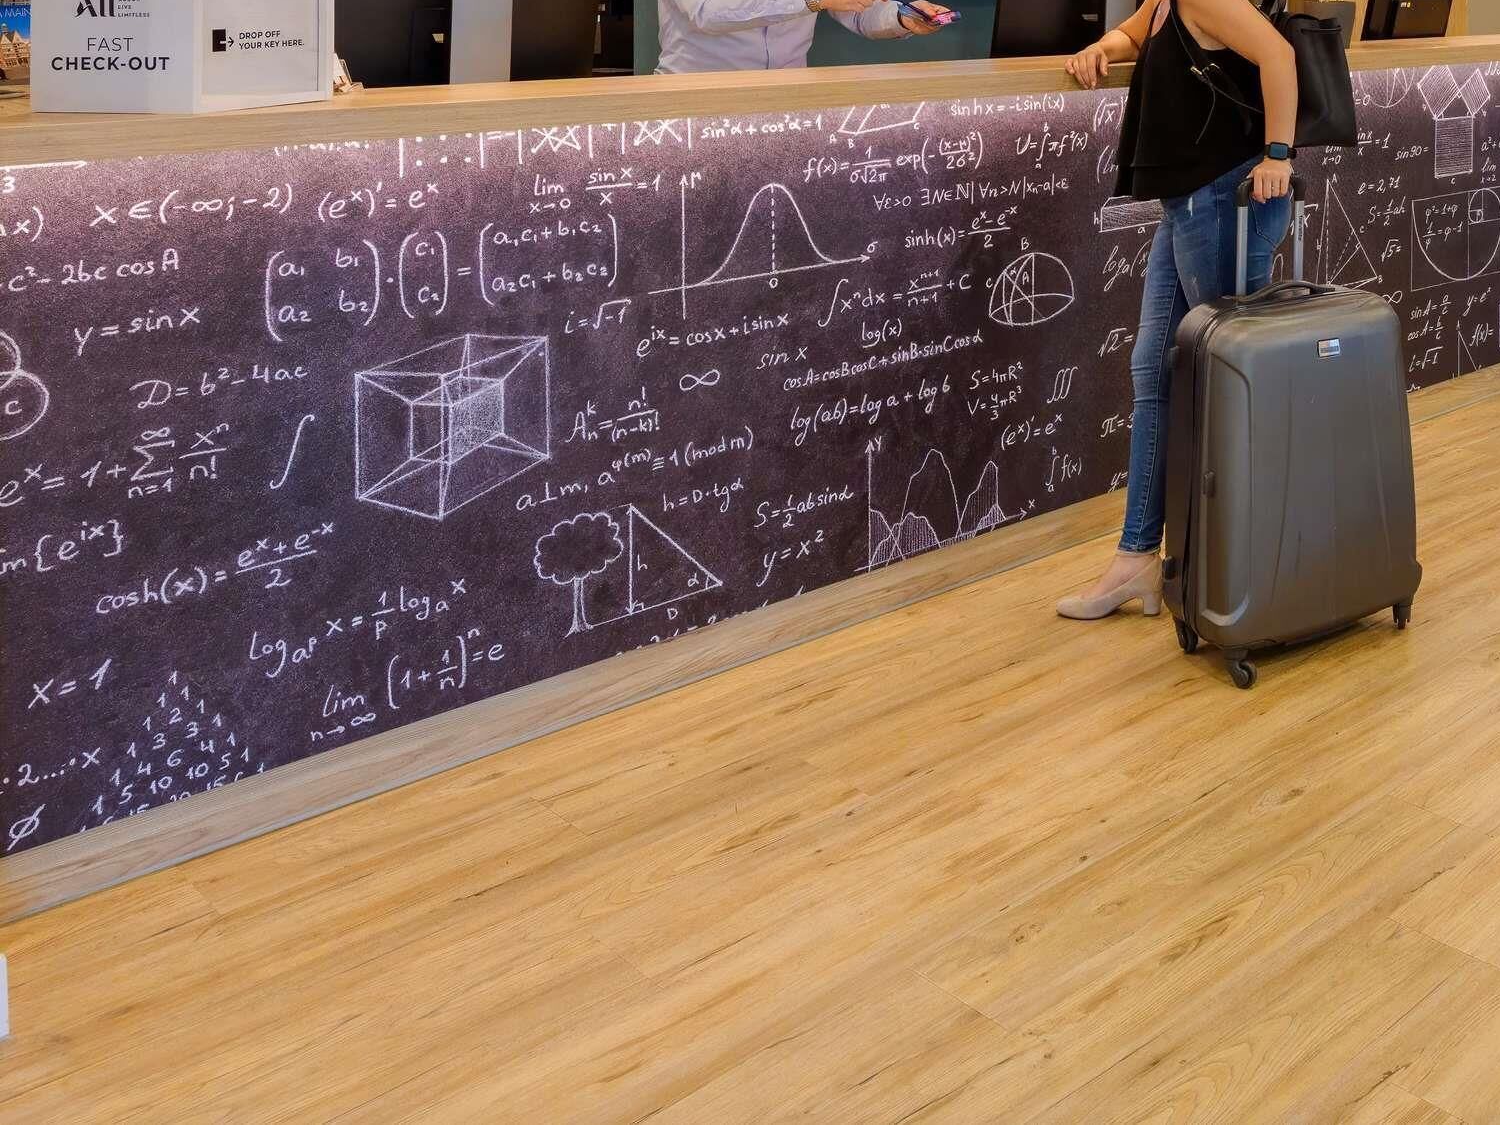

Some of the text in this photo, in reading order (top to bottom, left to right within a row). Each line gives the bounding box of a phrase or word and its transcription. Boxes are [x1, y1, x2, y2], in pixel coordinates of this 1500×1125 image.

[239, 30, 281, 40] DROP OFF
[87, 37, 134, 52] FAST
[239, 38, 305, 50] YOUR KEY HERE.
[51, 56, 170, 71] CHECK-OUT
